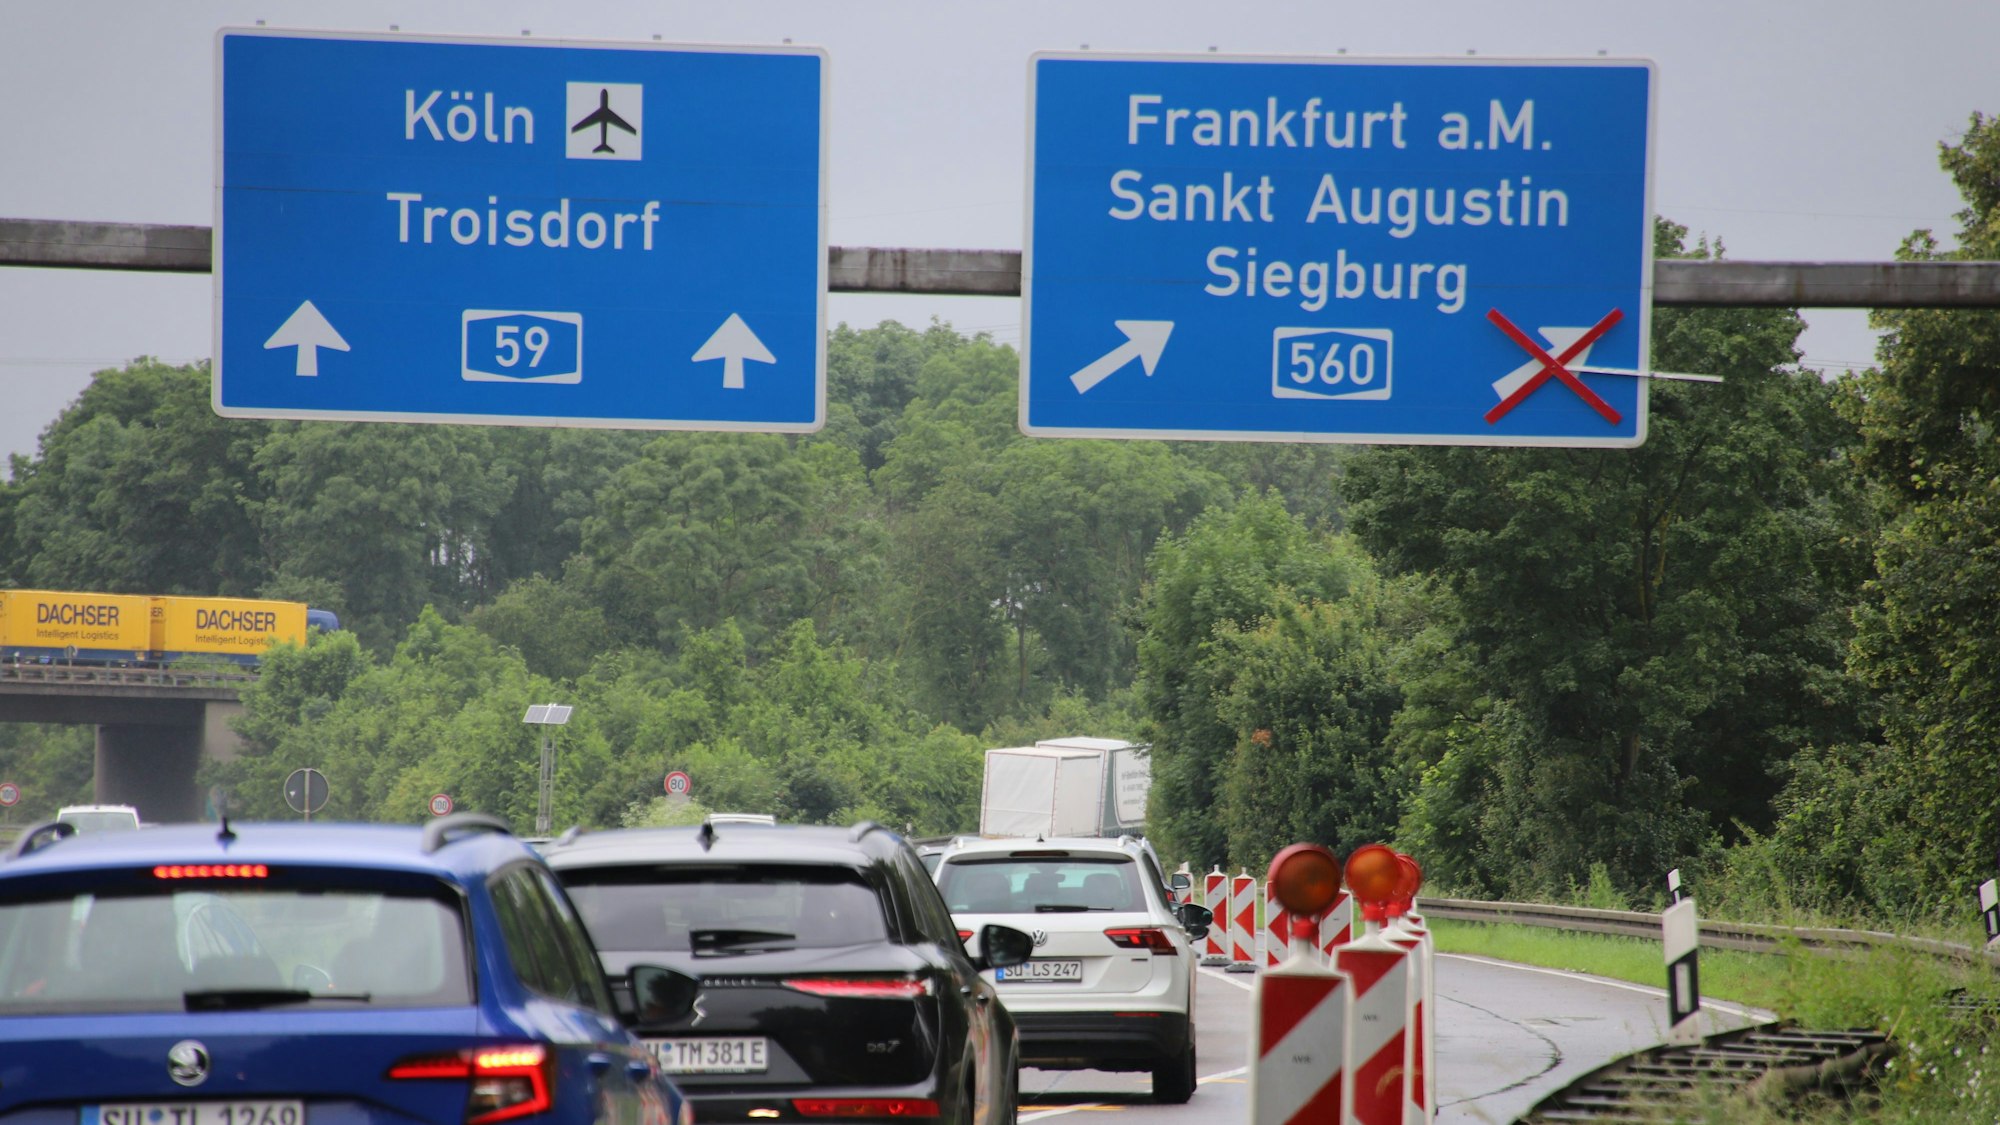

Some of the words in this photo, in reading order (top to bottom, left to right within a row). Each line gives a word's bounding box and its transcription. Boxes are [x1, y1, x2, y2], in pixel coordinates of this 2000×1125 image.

[404, 88, 535, 144] Köln
[1127, 94, 1408, 150] Frankfurt
[1437, 98, 1553, 151] a.M.
[1108, 169, 1276, 223] Sankt
[1306, 173, 1570, 239] Augustin
[386, 191, 661, 251] Troisdorf
[1203, 246, 1469, 314] Siegburg
[494, 325, 550, 368] 59
[1289, 342, 1376, 386] 560
[36, 603, 120, 627] DACHSER
[196, 609, 276, 632] DACHSER
[36, 629, 79, 641] Intelligent
[81, 630, 119, 641] Logistics
[195, 634, 237, 645] Intelligent
[671, 778, 684, 790] 80
[434, 799, 448, 811] 100
[1032, 963, 1050, 977] LS
[1053, 963, 1079, 977] 247
[675, 1041, 702, 1065] TM
